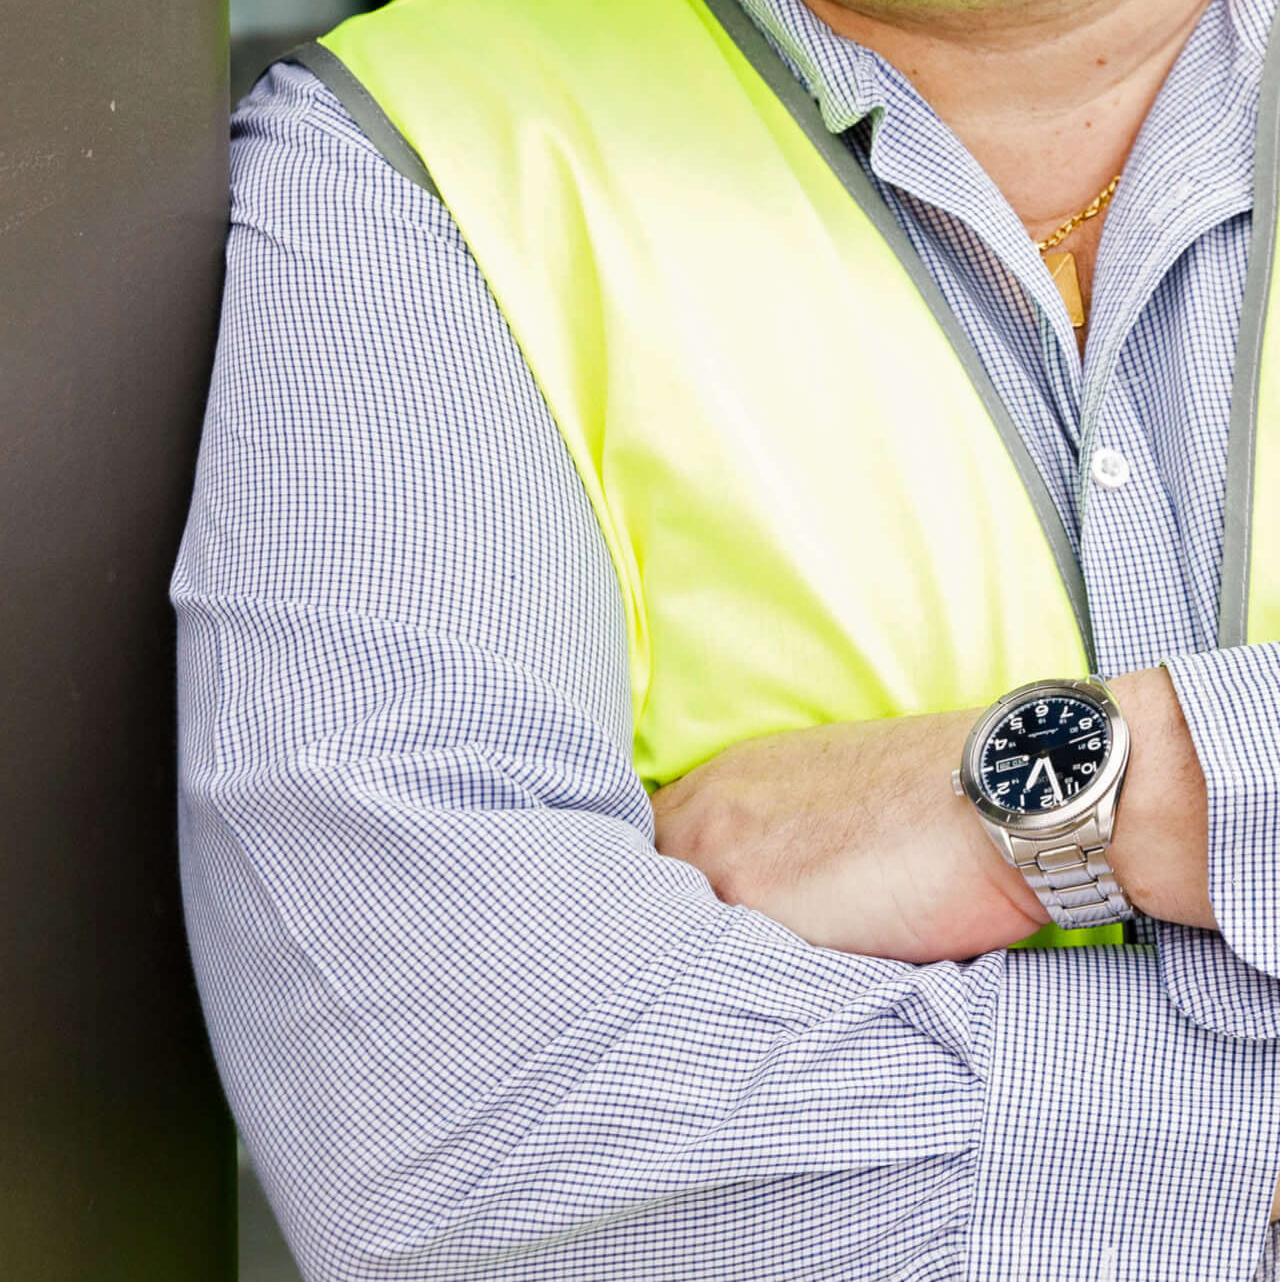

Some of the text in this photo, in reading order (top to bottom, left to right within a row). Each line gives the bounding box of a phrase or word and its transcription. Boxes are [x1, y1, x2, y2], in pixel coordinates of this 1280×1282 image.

[1035, 705, 1049, 718] 6
[1060, 706, 1074, 719] 7
[1010, 717, 1023, 730] 5
[1079, 717, 1093, 730] 8
[995, 738, 1008, 751] 4
[1087, 738, 1101, 751] 9
[1081, 761, 1097, 775] 10
[996, 781, 1010, 795] 2
[1067, 781, 1080, 795] 11
